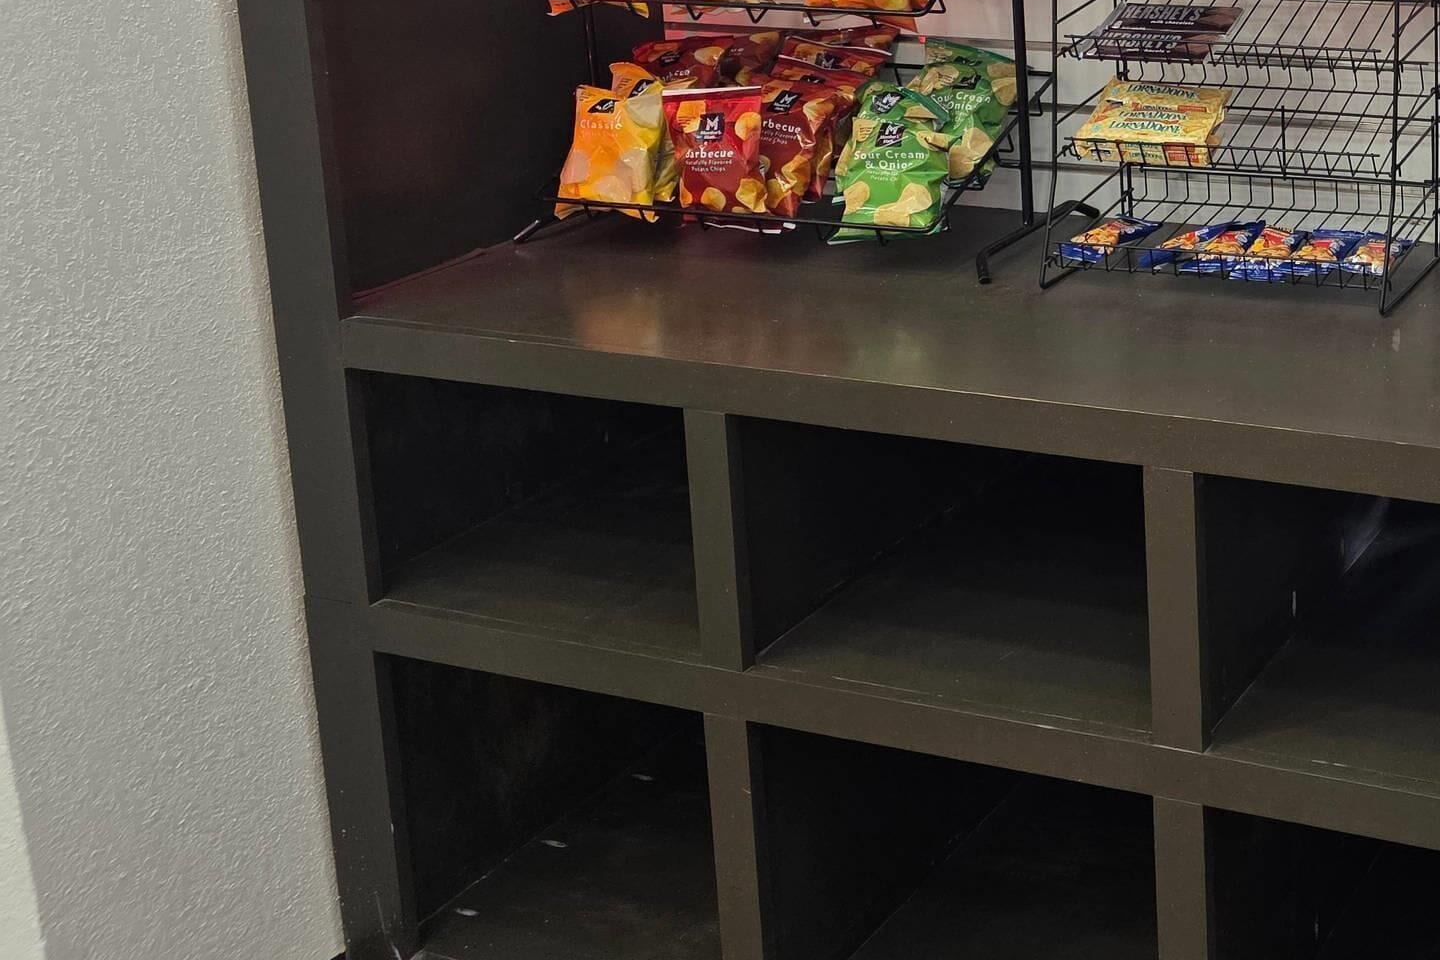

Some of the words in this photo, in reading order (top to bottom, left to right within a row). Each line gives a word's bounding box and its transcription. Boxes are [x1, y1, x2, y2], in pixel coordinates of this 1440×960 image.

[1120, 5, 1205, 21] HERSHEY'S
[580, 119, 623, 130] Classic
[762, 118, 802, 134] rbecue
[854, 151, 881, 160] Sour
[885, 150, 925, 160] Cream
